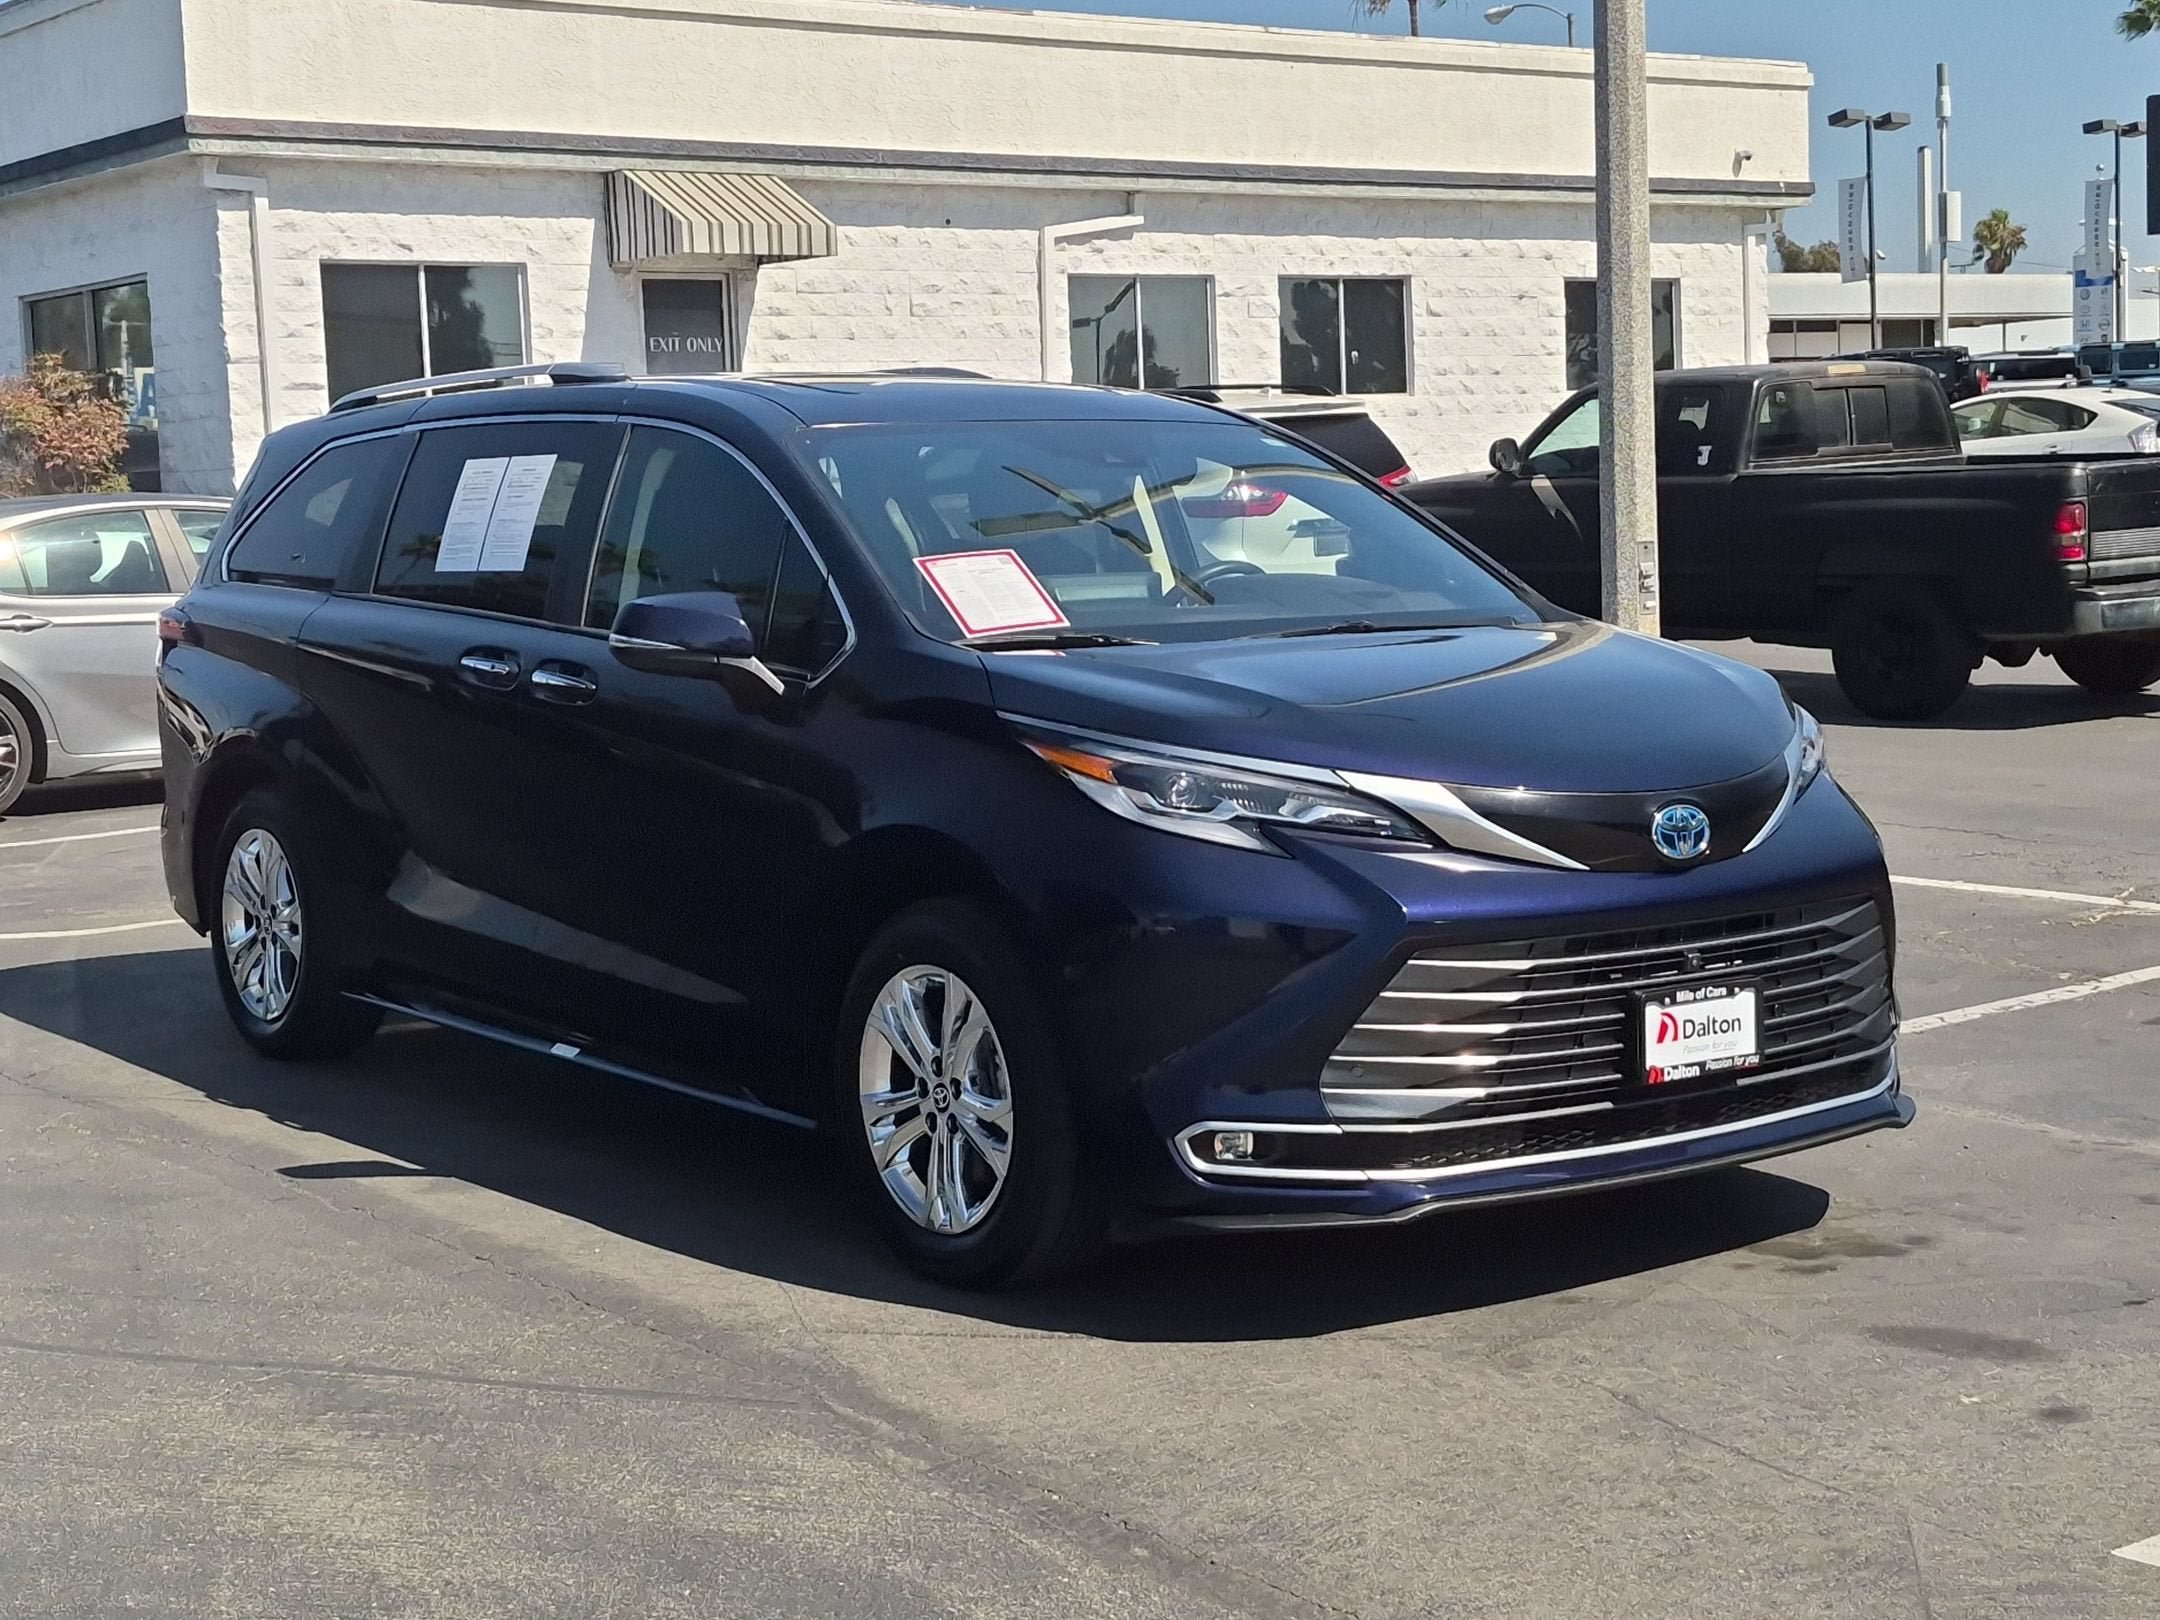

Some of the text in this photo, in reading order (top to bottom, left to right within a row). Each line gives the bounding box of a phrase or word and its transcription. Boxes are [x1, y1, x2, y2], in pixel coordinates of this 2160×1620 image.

[649, 336, 724, 353] EXIT ONLY
[1695, 987, 1706, 999] of
[1706, 986, 1727, 997] Cars
[1683, 1015, 1742, 1039] Dalton
[1664, 1055, 1760, 1082] Dalton Passion for you
